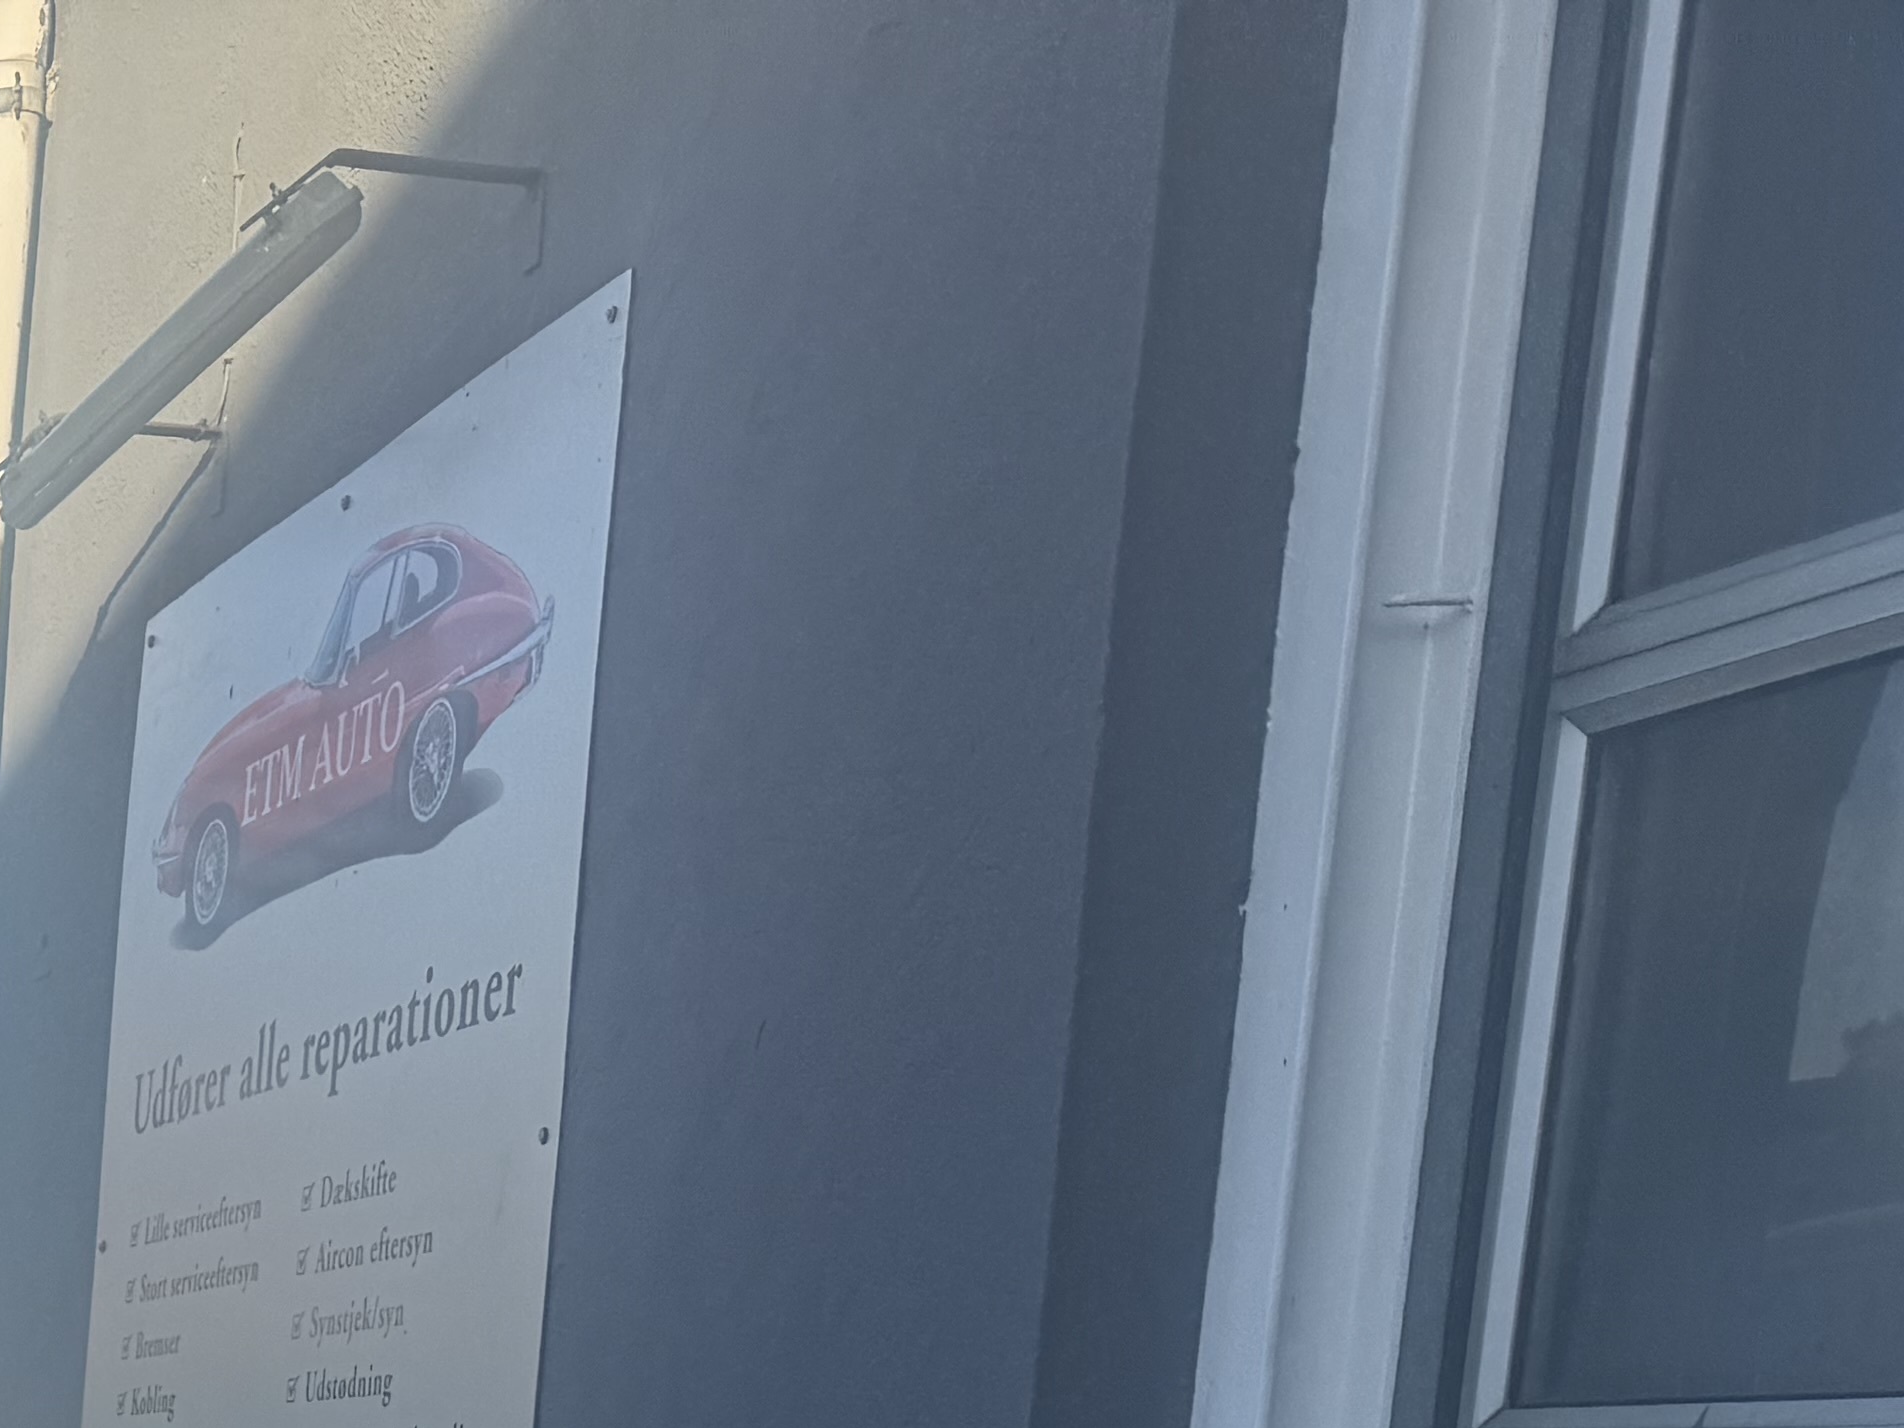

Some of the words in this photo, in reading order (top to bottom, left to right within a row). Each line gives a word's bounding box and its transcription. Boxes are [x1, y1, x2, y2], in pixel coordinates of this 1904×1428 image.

[241, 734, 306, 827] ETM
[308, 681, 405, 792] AUTO
[134, 1054, 231, 1134] Udfører
[239, 1018, 291, 1100] alle
[299, 963, 523, 1097] reparationer
[320, 1159, 397, 1209] Dækskifte
[145, 1212, 170, 1245] Lille
[173, 1195, 262, 1239] serviceeftersyn
[314, 1239, 364, 1274] Aircon
[370, 1225, 433, 1268] eftersyn
[140, 1273, 168, 1302] Stort
[171, 1256, 259, 1297] serviceeftersyn
[135, 1331, 181, 1360] Bremser
[309, 1295, 404, 1349] Synstjek/syn
[130, 1384, 176, 1423] Kobling
[305, 1364, 393, 1408] Udstødning
